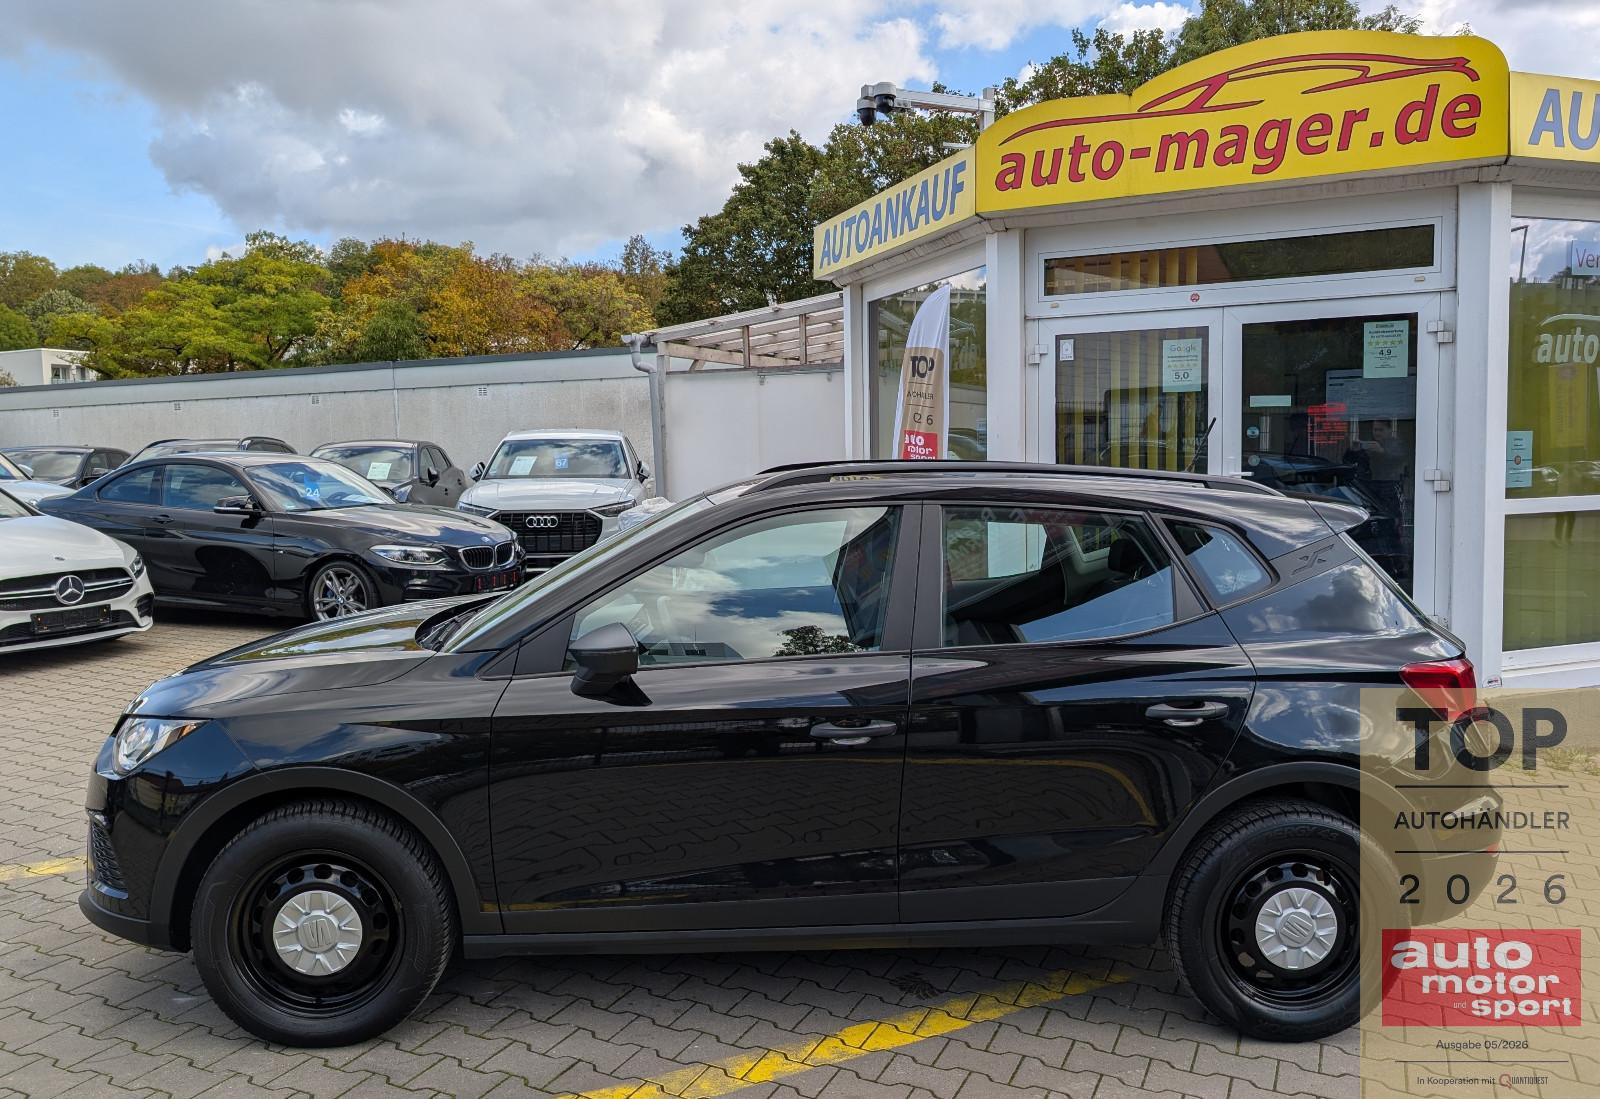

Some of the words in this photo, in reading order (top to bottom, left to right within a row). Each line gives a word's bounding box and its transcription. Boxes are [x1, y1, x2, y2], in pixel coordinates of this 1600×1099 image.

[995, 84, 1482, 192] auto-mager.de
[1528, 88, 1600, 150] AU
[819, 160, 967, 269] AUTOANKAUF
[1174, 371, 1190, 381] 5,0
[1537, 327, 1599, 365] auto
